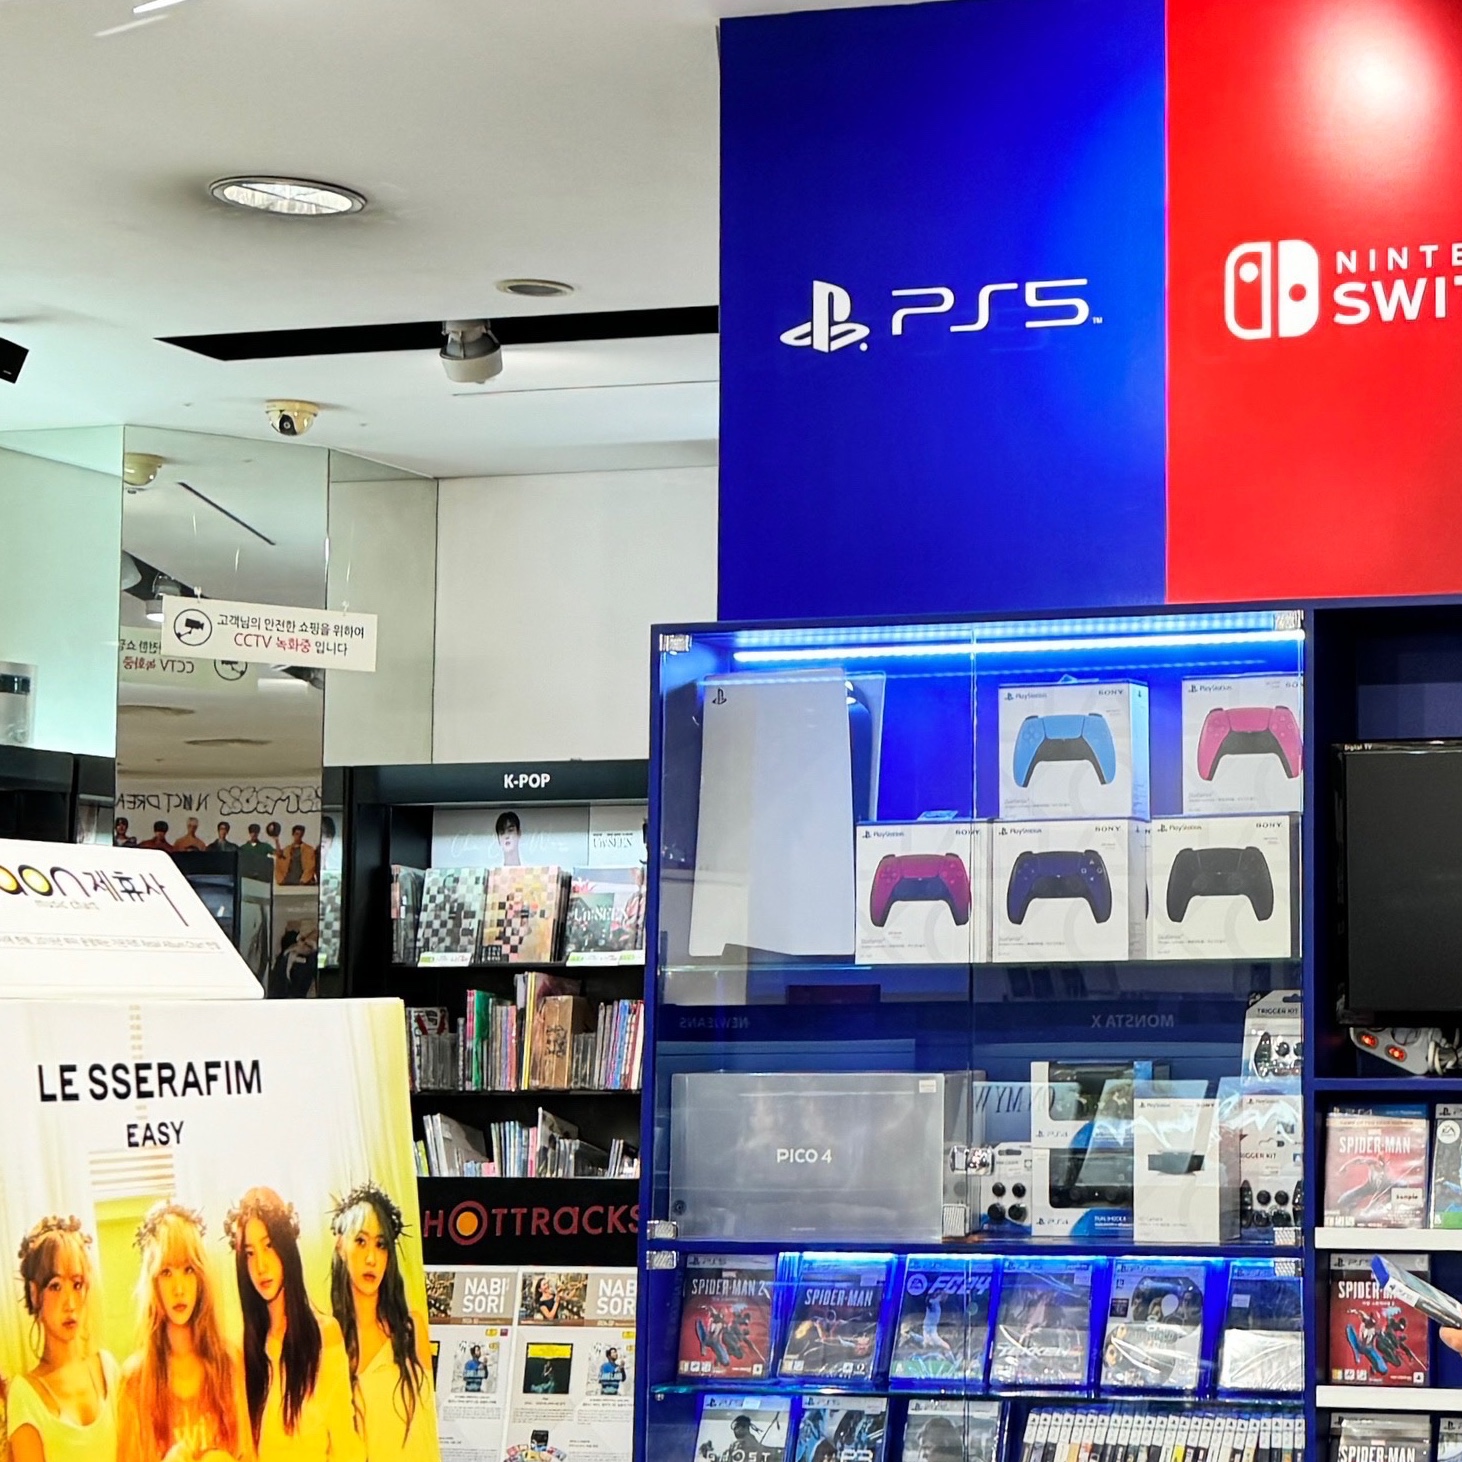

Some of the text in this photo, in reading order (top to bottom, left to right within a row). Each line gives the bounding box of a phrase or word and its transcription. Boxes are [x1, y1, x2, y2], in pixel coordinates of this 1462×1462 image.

[890, 277, 1090, 337] PS5
[217, 614, 365, 640] 고객님의 안전한 쇼핑을 위하여
[234, 633, 348, 657] CCTV 녹화중 입니다
[504, 773, 551, 789] K-POP
[1257, 1007, 1299, 1016] TRIGGER KIT
[37, 1059, 263, 1103] LE SSERAFIM
[126, 1120, 185, 1148] EASY
[1339, 1136, 1411, 1154] SPIDER-MAN
[776, 1148, 833, 1163] PICO 4
[1240, 1152, 1264, 1160] IGGER
[423, 1200, 640, 1246] HOTTRACKS
[465, 1277, 506, 1296] NABI
[599, 1278, 638, 1297] NAB
[691, 1278, 757, 1297] SPIDER-MAN
[1338, 1280, 1396, 1299] SPIDER-
[462, 1296, 505, 1314] SORI
[596, 1297, 637, 1315] SOR
[804, 1288, 874, 1308] SPIDER-MAN
